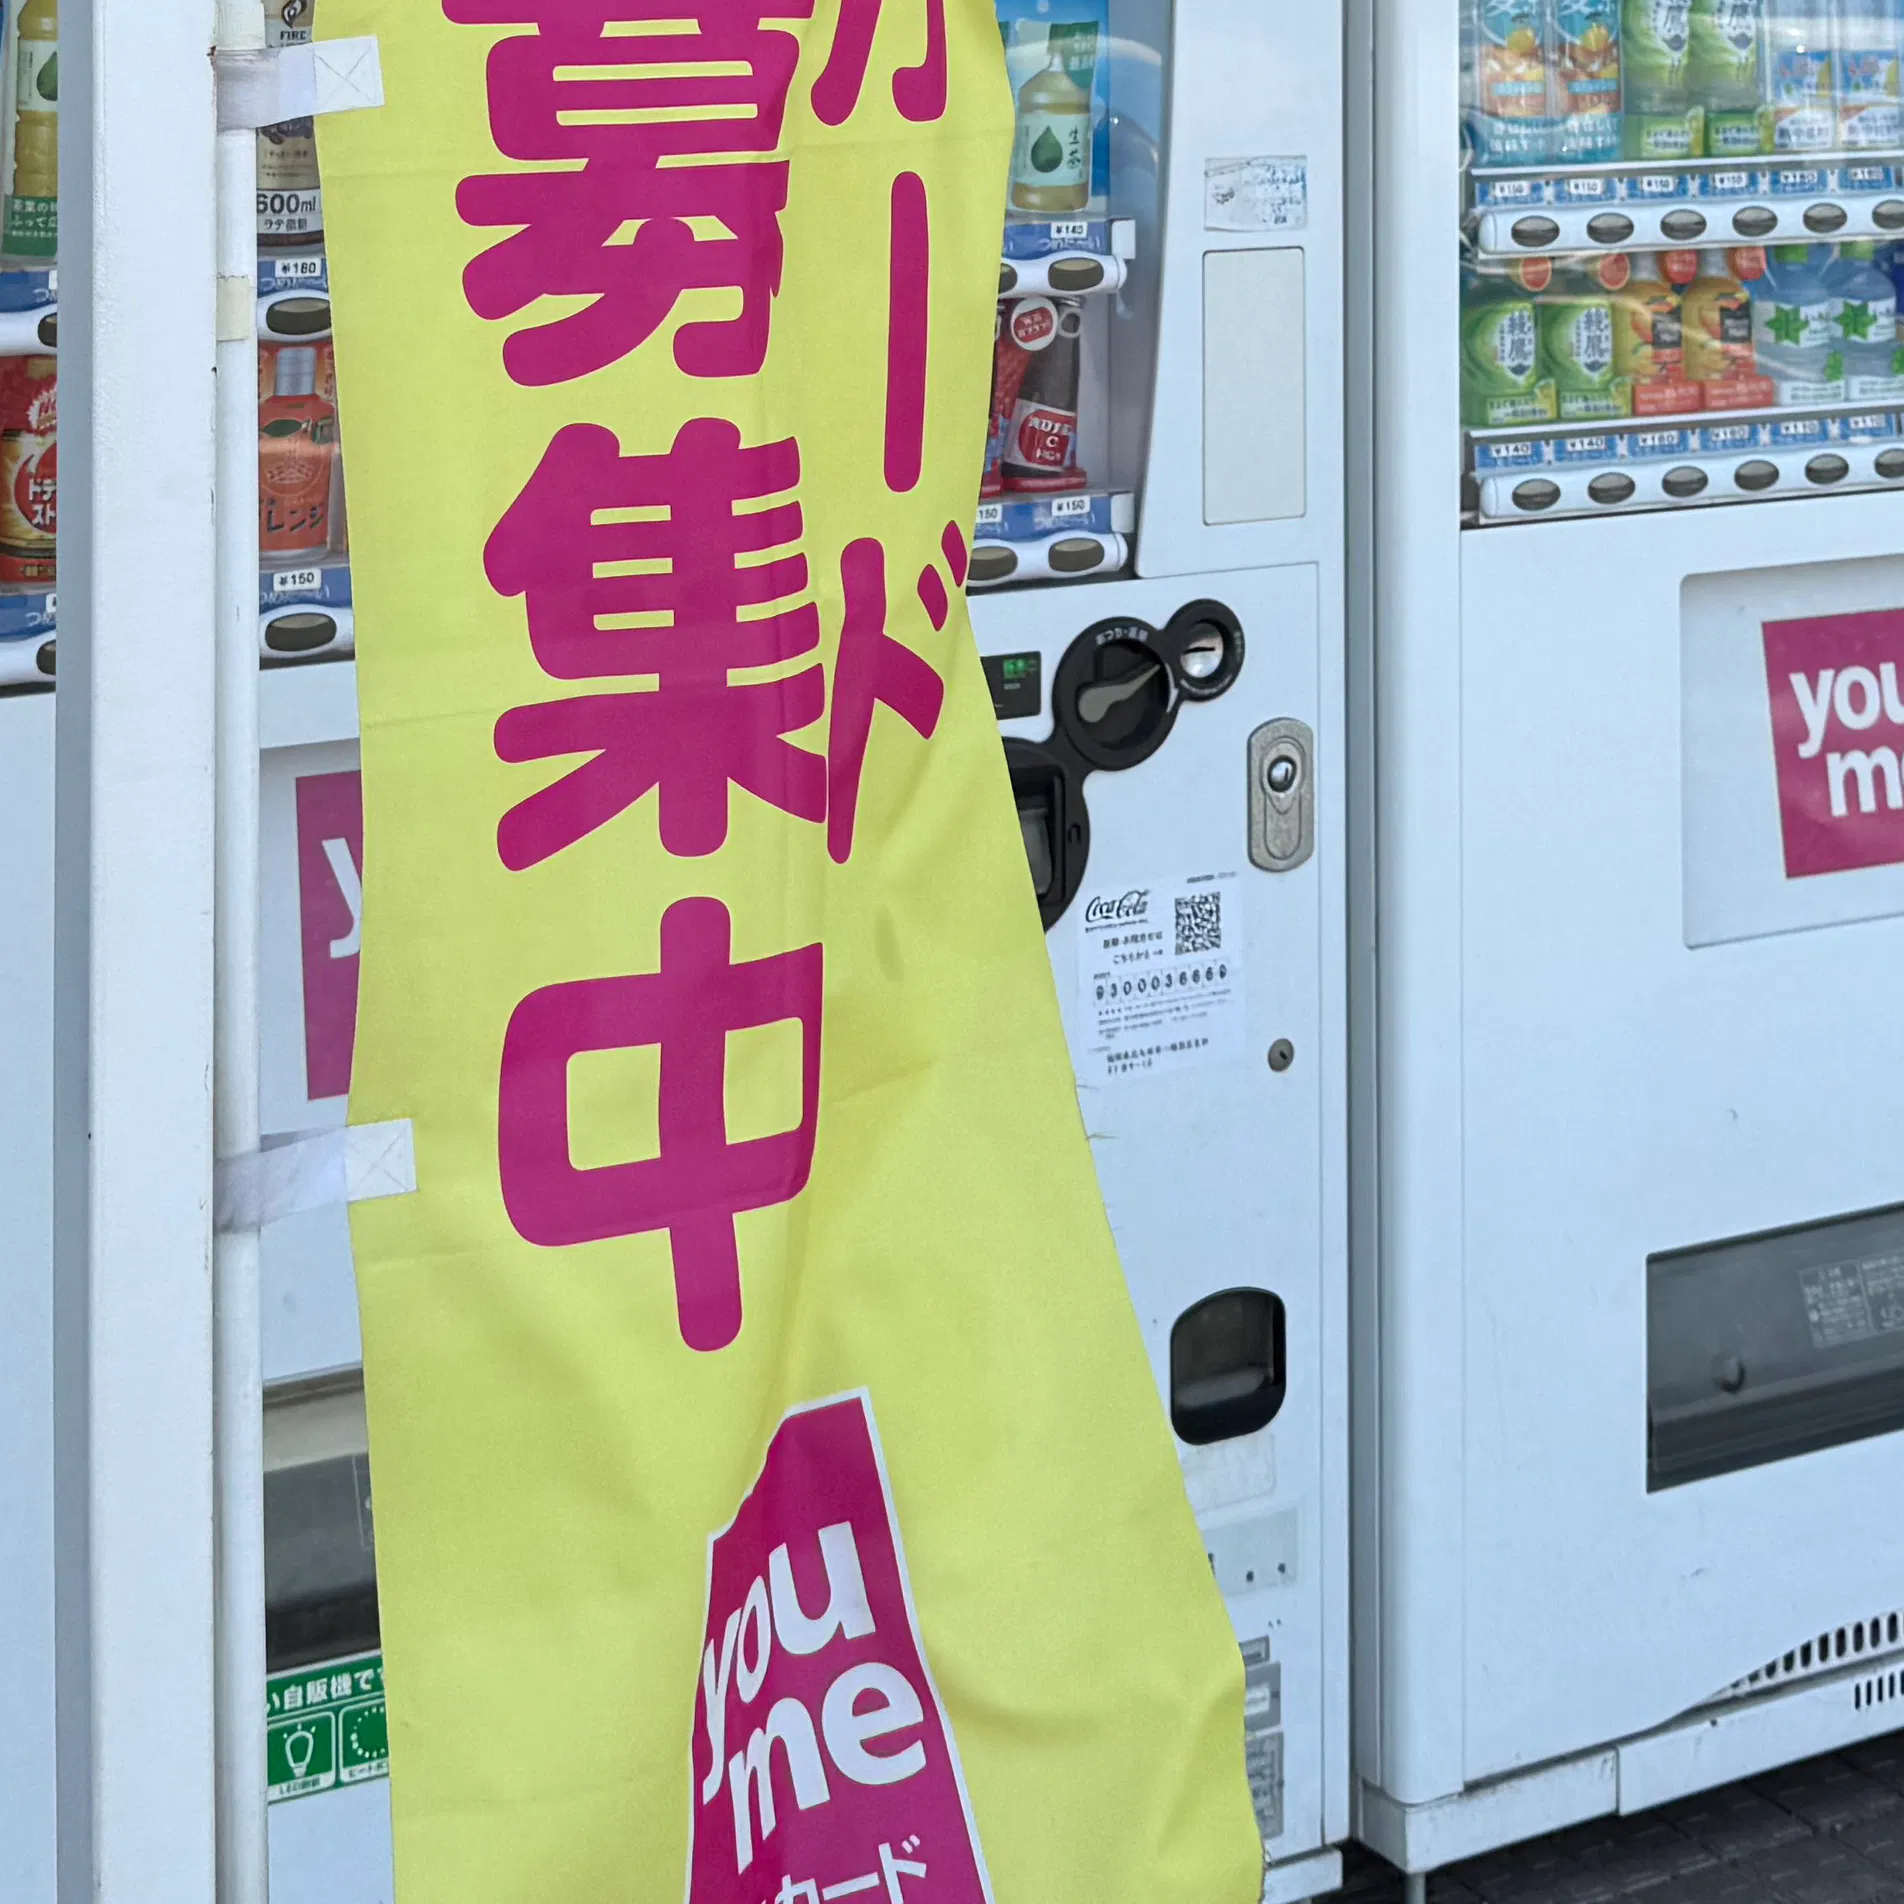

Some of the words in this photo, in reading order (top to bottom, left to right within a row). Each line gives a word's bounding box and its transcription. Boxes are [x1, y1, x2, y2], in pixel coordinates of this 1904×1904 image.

[279, 30, 307, 42] FIRE
[256, 193, 317, 215] 600ml
[259, 500, 325, 534] レンジ
[700, 1519, 878, 1806] you
[727, 1658, 929, 1876] me
